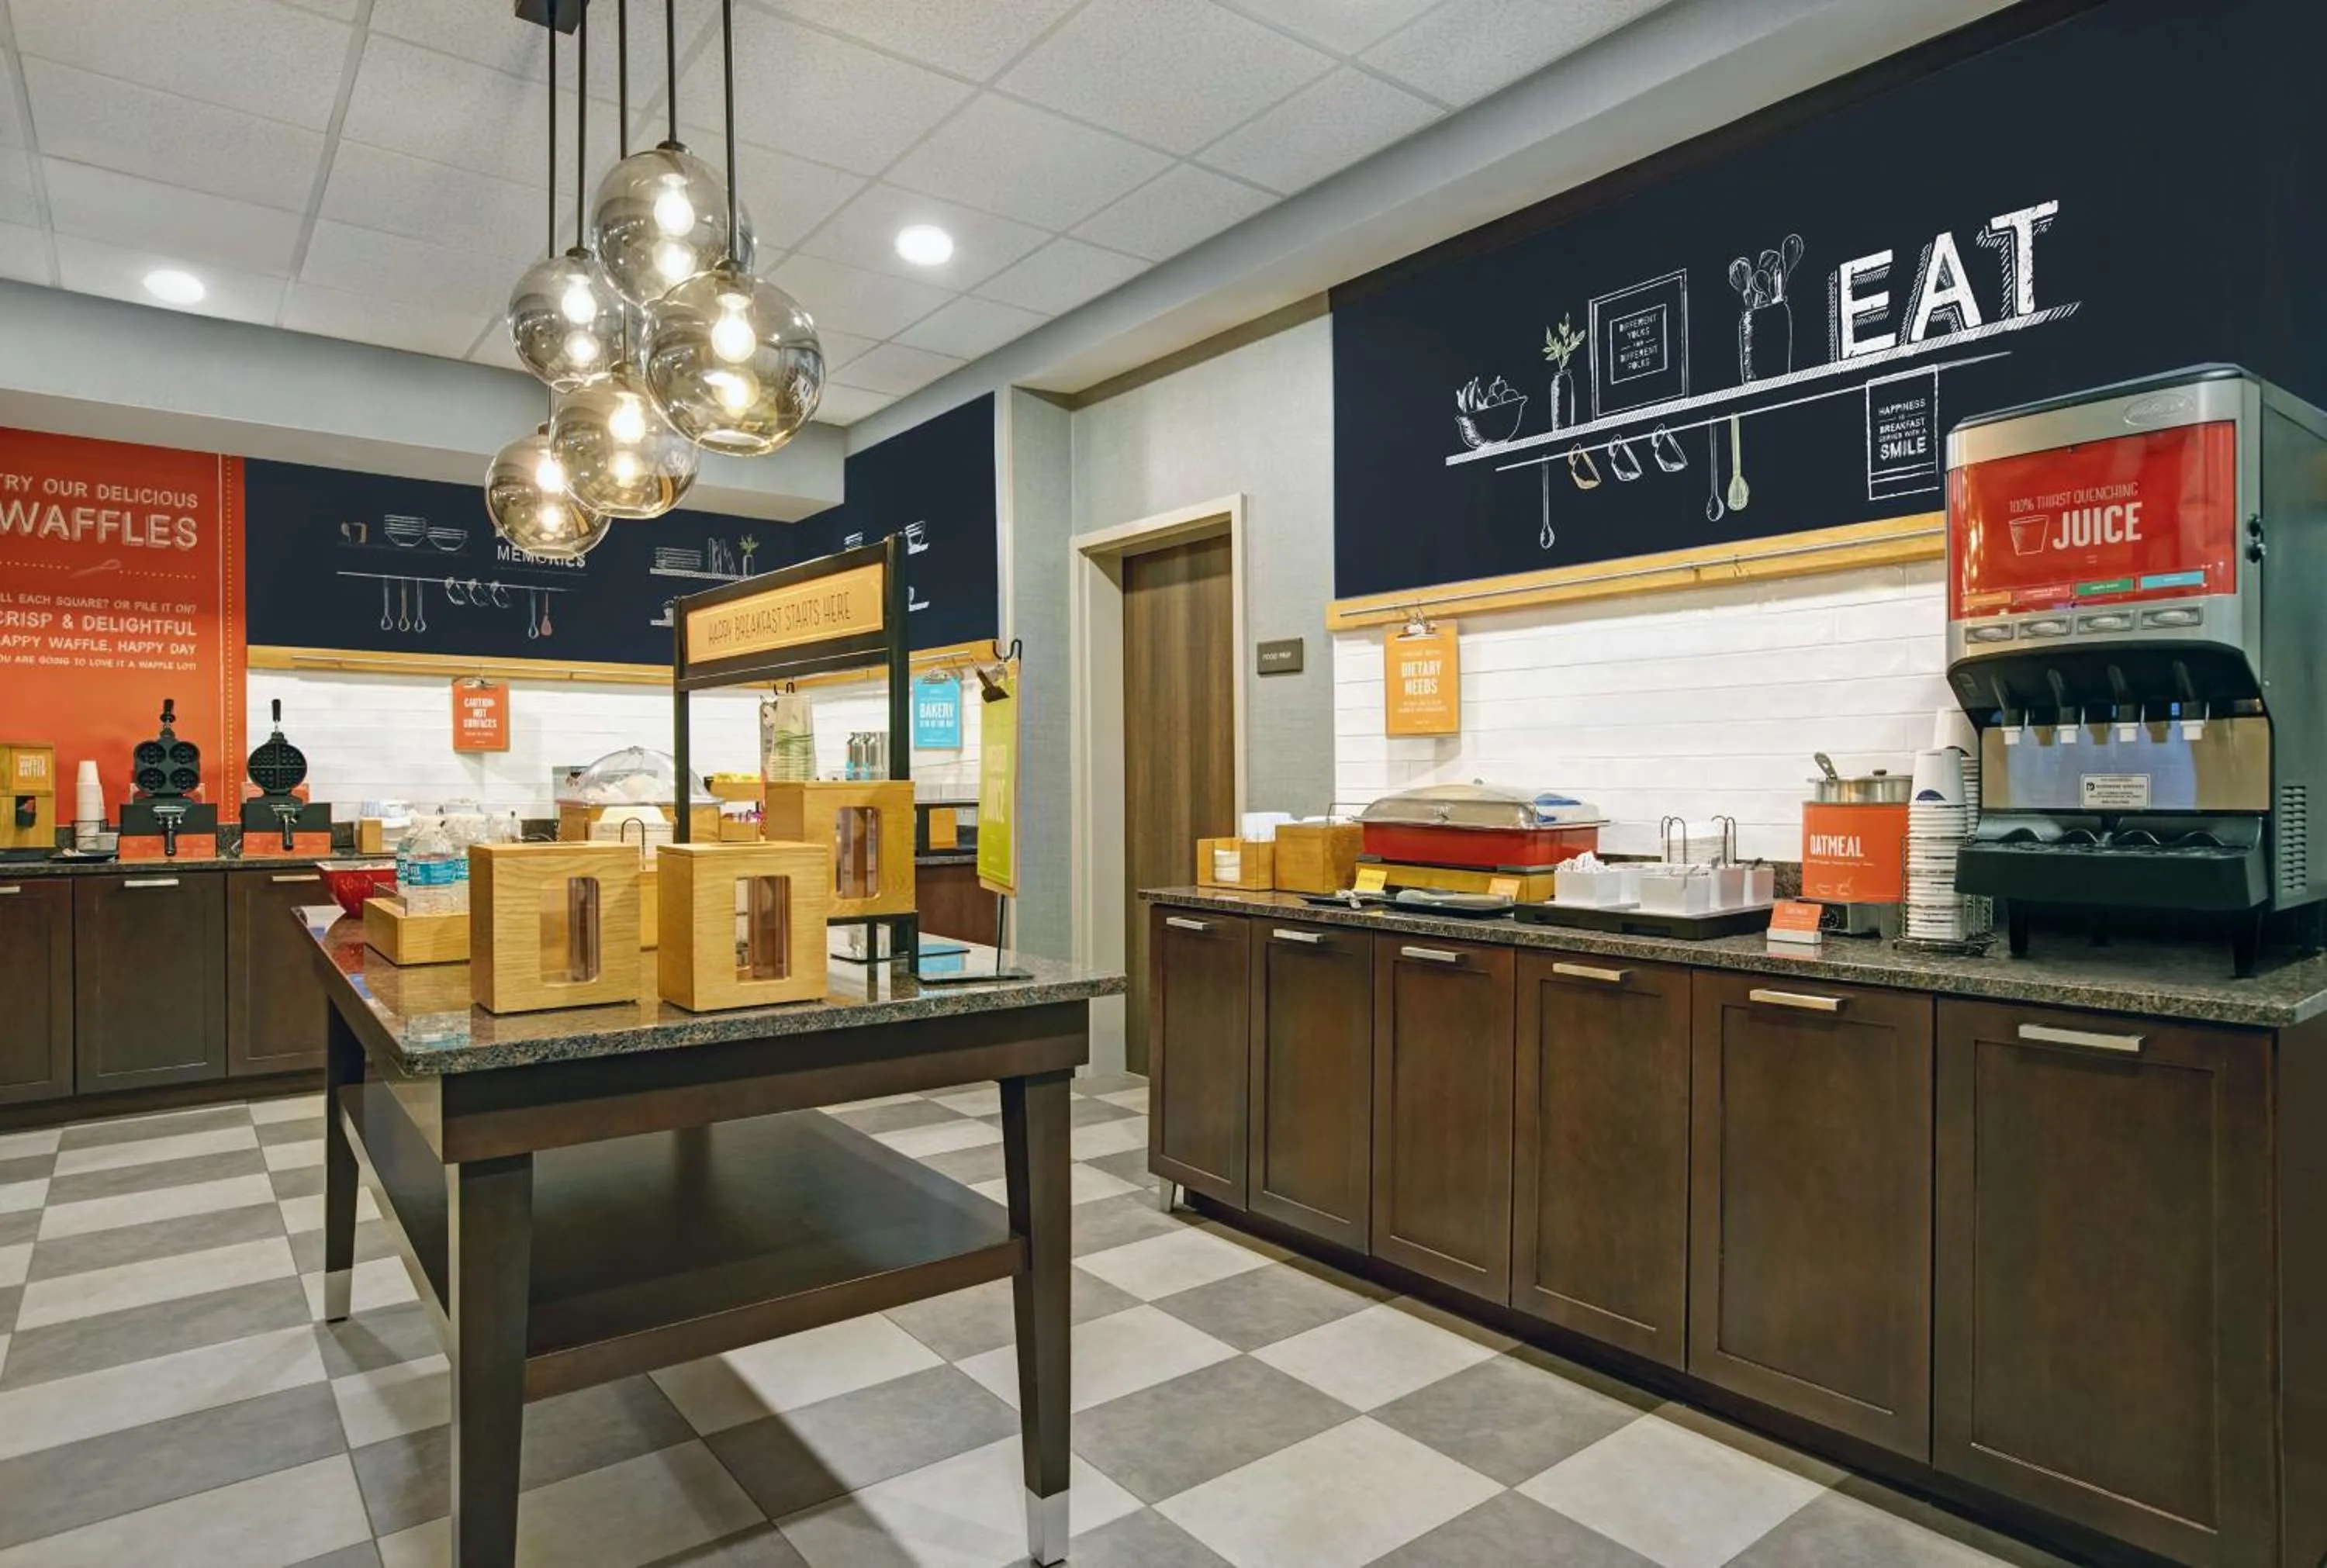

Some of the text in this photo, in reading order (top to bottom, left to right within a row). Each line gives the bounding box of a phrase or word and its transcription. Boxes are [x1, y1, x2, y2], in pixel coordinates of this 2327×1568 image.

[1831, 199, 2059, 360] EAT
[1878, 398, 1926, 416] HAPPINESS
[1879, 416, 1925, 434] BREAKFAST
[1879, 436, 1927, 461] SMILE
[43, 478, 88, 498] OUR
[96, 483, 199, 509] DELICIOUS
[2036, 491, 2072, 509] THIRST
[2073, 481, 2139, 504] QUENCHING
[0, 499, 199, 551] WAFFLES
[2052, 501, 2143, 550] JUICE
[113, 599, 130, 610] OR
[62, 613, 74, 630] &
[81, 615, 197, 636] DELIGHTFUL
[708, 591, 851, 647] HAPPY BREAKFAST STARTS HERE
[117, 640, 164, 654] HAPPY
[170, 642, 197, 655] DAY
[1402, 660, 1441, 679] DIETARY
[1405, 678, 1438, 696] NEEDS
[919, 702, 955, 719] BAKERY
[1810, 834, 1865, 857] OATMEAL
